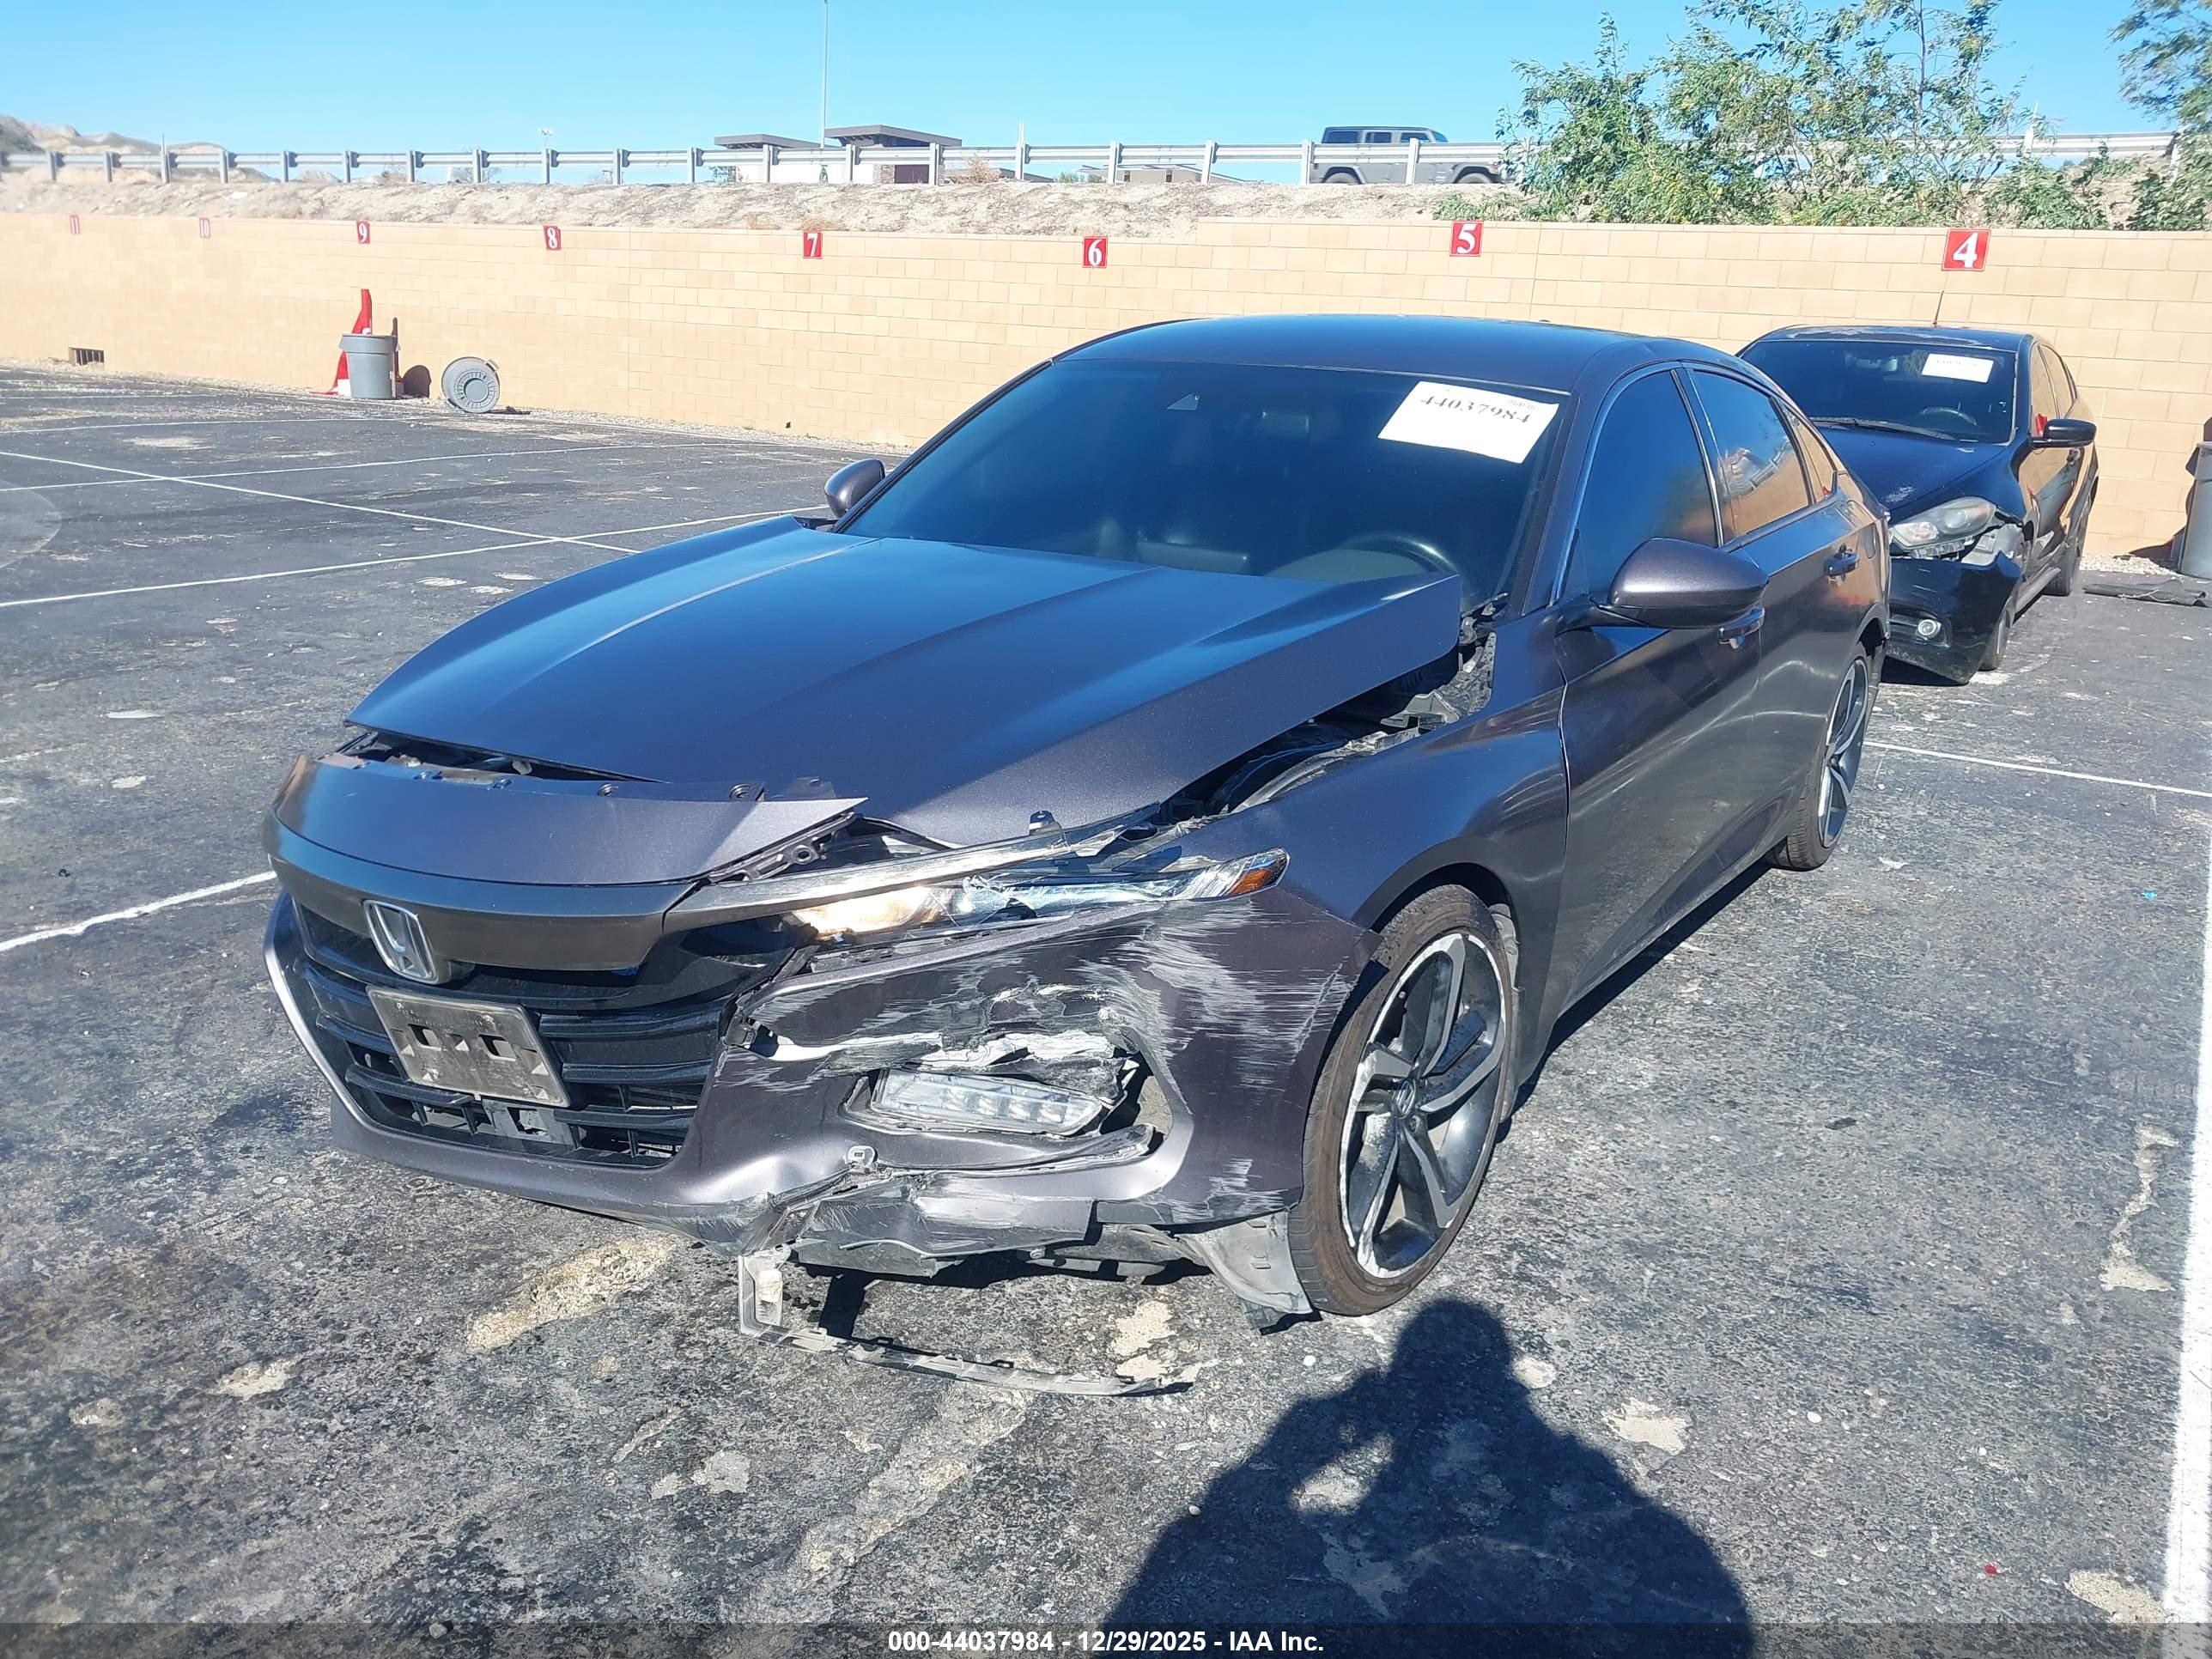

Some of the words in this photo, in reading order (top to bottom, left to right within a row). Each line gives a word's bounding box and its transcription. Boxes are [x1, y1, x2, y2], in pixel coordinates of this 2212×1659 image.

[199, 219, 210, 238] 10
[358, 222, 368, 243] 9
[547, 227, 558, 249] 8
[1456, 223, 1477, 254] 5
[806, 233, 818, 257] 7
[1087, 239, 1102, 266] 6
[1952, 233, 1978, 269] 4
[1419, 395, 1531, 423] 44037984
